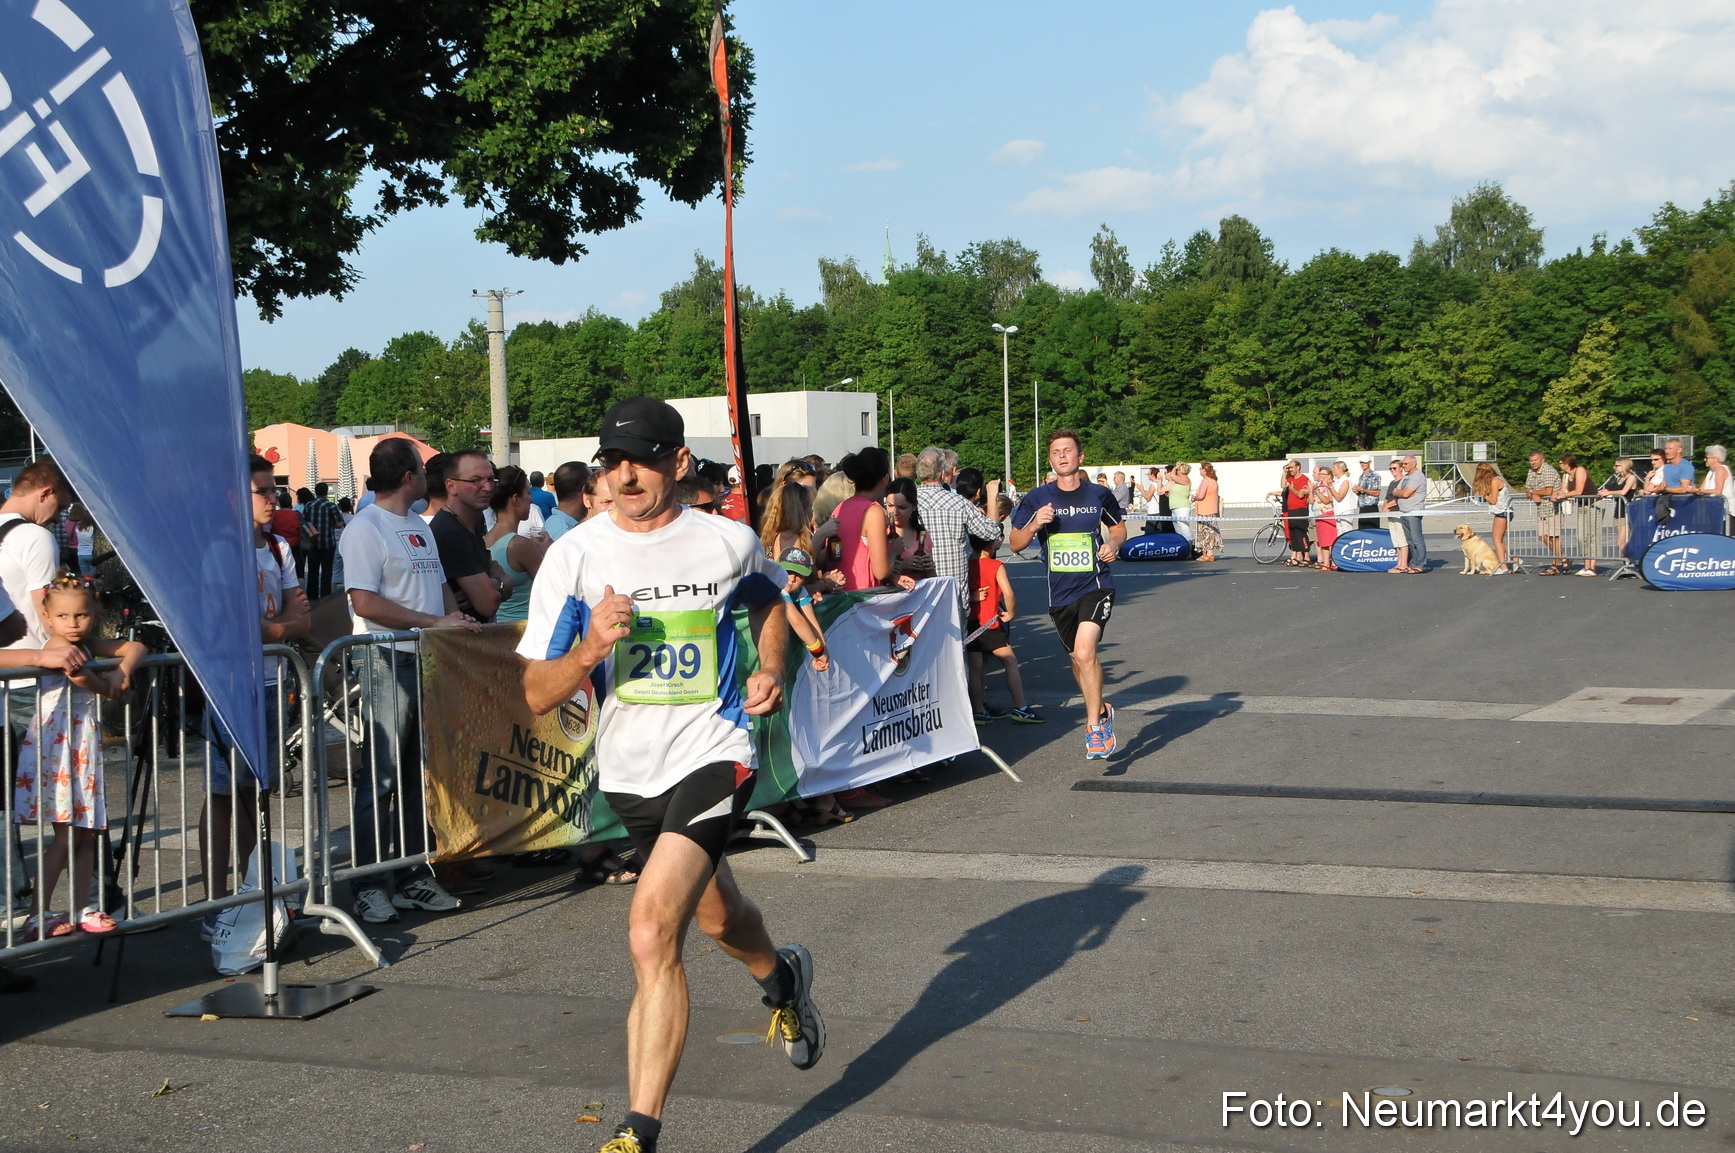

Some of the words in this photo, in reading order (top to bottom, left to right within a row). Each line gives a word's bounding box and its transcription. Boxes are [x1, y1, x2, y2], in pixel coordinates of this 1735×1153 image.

[1076, 506, 1098, 514] POLES
[1052, 551, 1090, 567] 5088
[1138, 545, 1181, 557] Fischer
[1351, 546, 1398, 558] Fische
[1669, 557, 1735, 572] Fische
[1676, 570, 1735, 578] AUTOMOBILE
[630, 582, 718, 601] ELPHI
[628, 643, 701, 680] 209
[871, 682, 931, 718] Neumarkter
[564, 716, 581, 735] 1628
[861, 703, 943, 755] Lammsbräu
